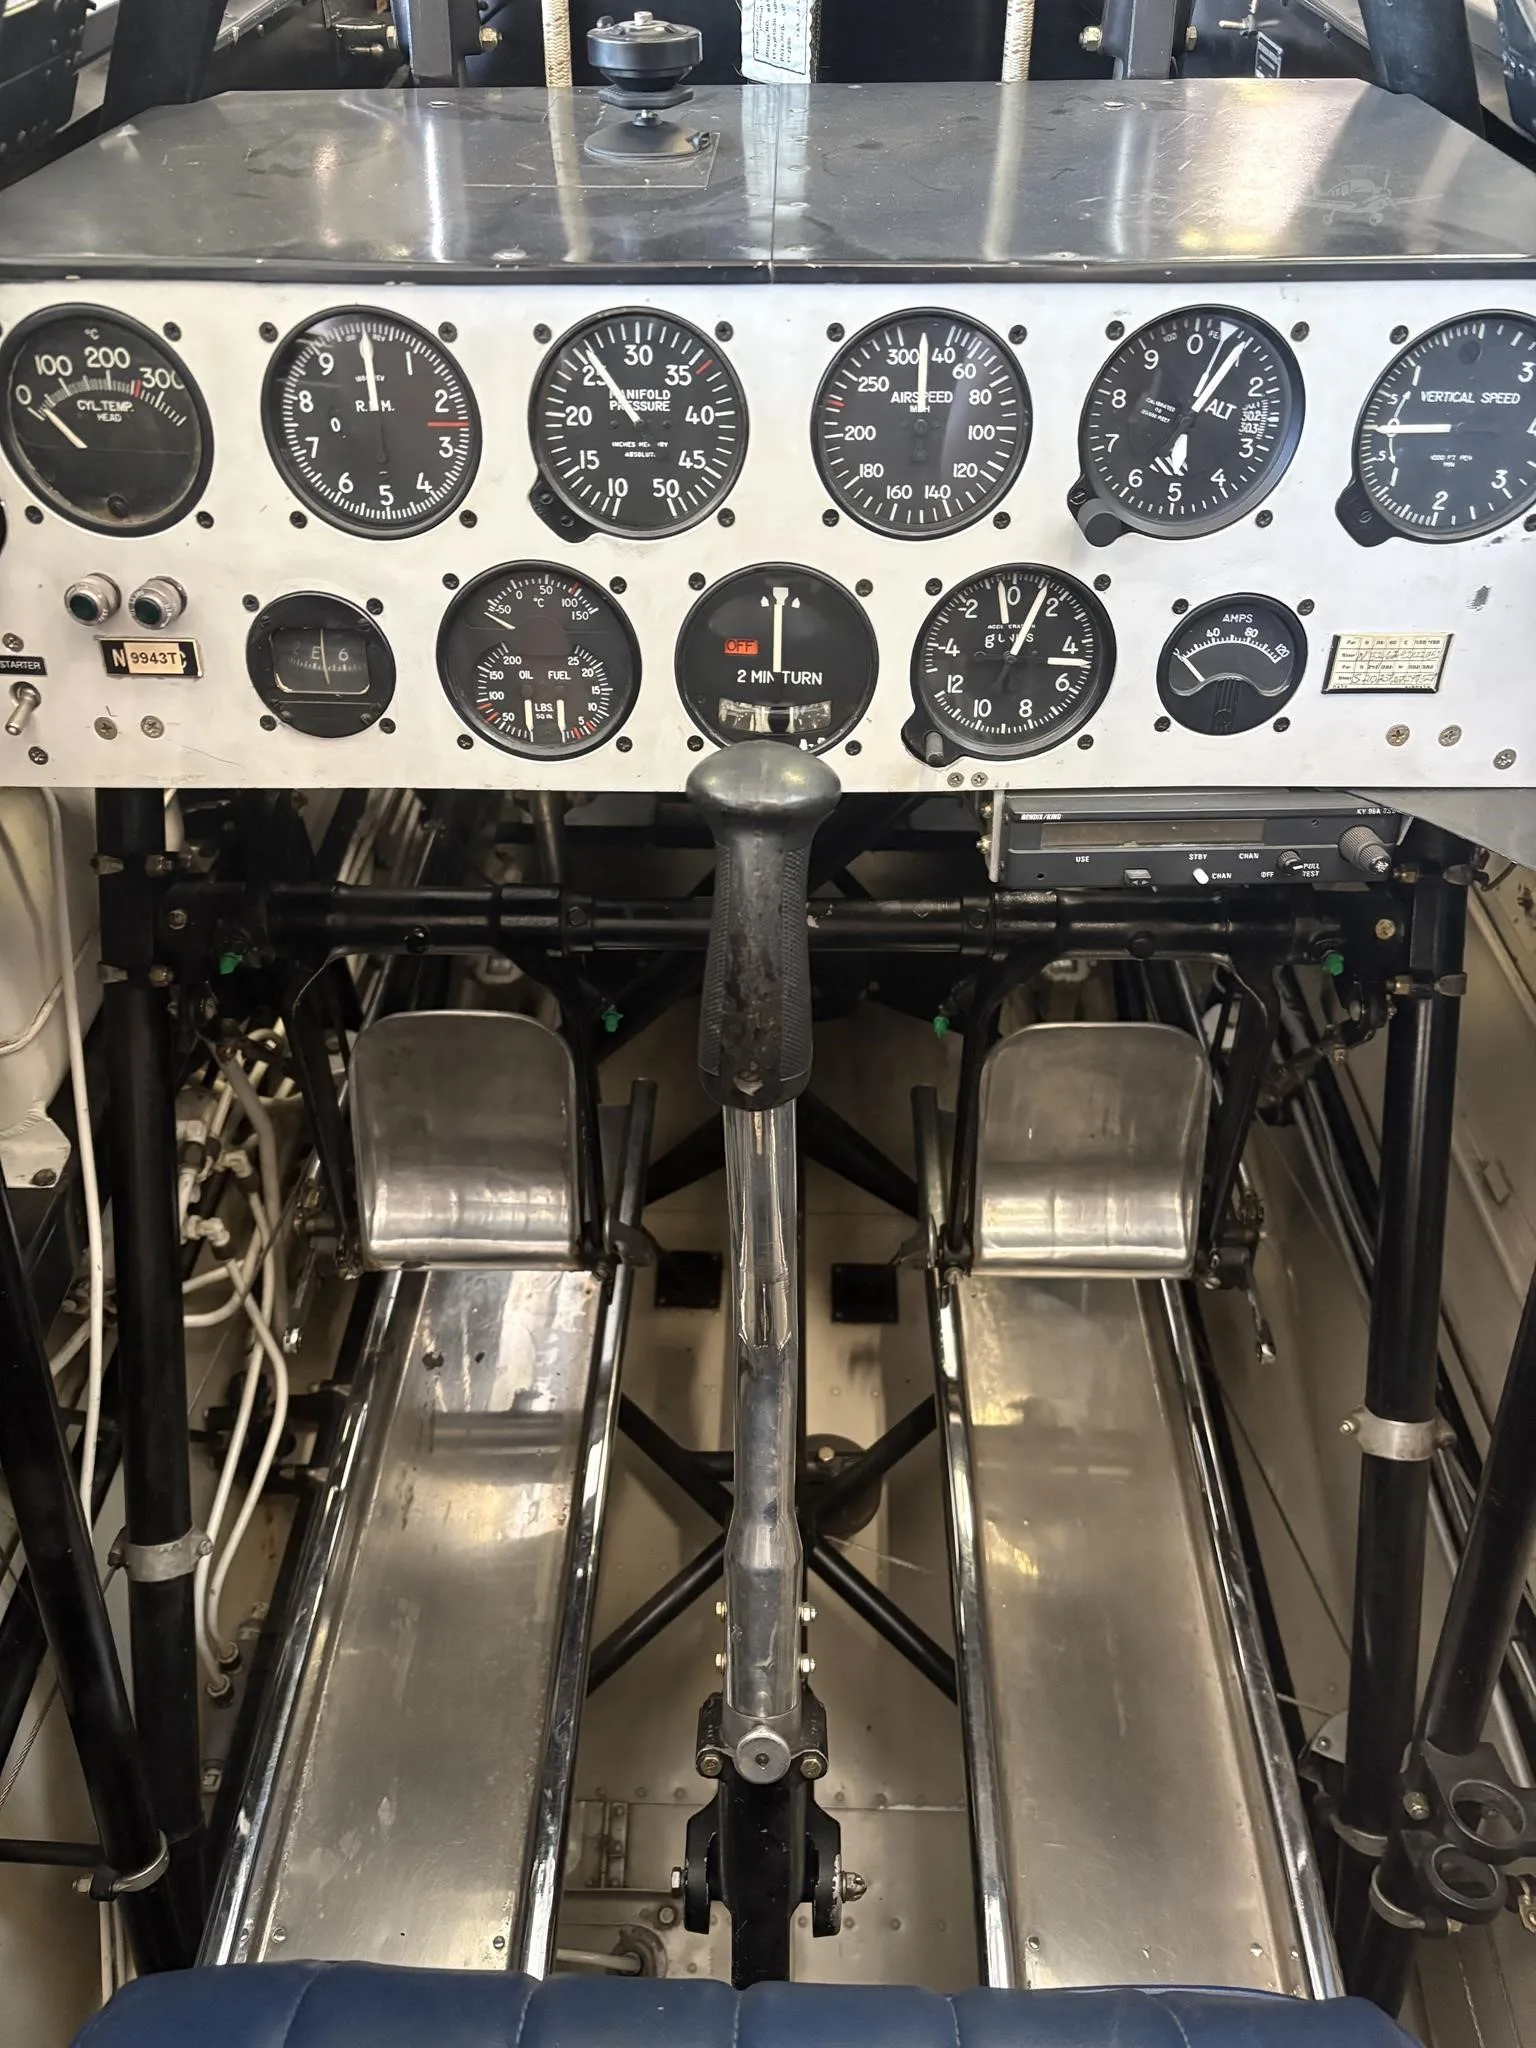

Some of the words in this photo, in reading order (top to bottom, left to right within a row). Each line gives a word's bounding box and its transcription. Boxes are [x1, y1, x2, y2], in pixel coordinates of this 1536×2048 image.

[1186, 333, 1204, 355] 0
[84, 346, 130, 369] 200
[318, 352, 334, 376] 9
[406, 351, 413, 375] 1
[624, 344, 653, 366] 30
[887, 349, 919, 365] 300
[932, 348, 956, 364] 40
[1144, 349, 1159, 370] 9
[34, 355, 73, 377] 100
[665, 364, 692, 386] 35
[952, 363, 976, 379] 60
[1518, 362, 1536, 382] 3
[139, 367, 185, 390] 300
[857, 376, 890, 392] 250
[1412, 366, 1421, 386] 1
[15, 384, 32, 405] 0
[1248, 377, 1263, 398] 2
[299, 390, 314, 413] 8
[435, 389, 450, 413] 2
[969, 389, 992, 405] 80
[1111, 389, 1127, 409] 8
[1421, 391, 1475, 403] VERTICAL
[1480, 392, 1521, 404] SPEED
[565, 406, 592, 426] 20
[685, 405, 715, 425] 40
[910, 405, 930, 413] MH
[1205, 398, 1237, 420] ALT
[330, 417, 341, 433] 0
[844, 425, 876, 441] 200
[968, 424, 995, 441] 100
[305, 436, 319, 459] 7
[439, 436, 454, 458] 3
[1106, 433, 1119, 452] 7
[1239, 438, 1253, 458] 3
[580, 450, 600, 470] 15
[678, 450, 706, 469] 45
[859, 463, 884, 478] 180
[953, 463, 978, 478] 120
[1129, 469, 1142, 487] 6
[1211, 469, 1226, 486] 4
[1390, 467, 1399, 486] 1
[1491, 469, 1508, 489] 3
[338, 472, 354, 494] 6
[416, 472, 432, 493] 4
[608, 478, 628, 497] 10
[652, 479, 680, 498] 50
[379, 485, 394, 506] 5
[886, 484, 913, 500] 160
[924, 484, 951, 500] 140
[1168, 483, 1182, 501] 5
[1432, 490, 1449, 510] 2
[516, 591, 523, 600] 0
[540, 585, 553, 595] 50
[1007, 586, 1021, 606] 0
[562, 598, 578, 608] 100
[958, 599, 978, 619] -2
[1045, 597, 1059, 617] 2
[572, 611, 589, 621] 150
[1222, 614, 1253, 623] AMPS
[1206, 627, 1221, 637] 40
[1244, 627, 1259, 638] 80
[727, 640, 753, 652] OFF
[938, 638, 960, 656] -4
[1063, 635, 1078, 654] 4
[1274, 643, 1290, 658] 120
[112, 648, 126, 668] N
[130, 652, 177, 664] 9943T
[311, 646, 321, 660] E
[338, 648, 349, 662] 6
[503, 656, 522, 665] 200
[568, 656, 580, 666] 25
[0, 660, 42, 670] STARTER
[582, 668, 594, 677] 20
[490, 671, 504, 680] 150
[519, 671, 533, 680] OIL
[548, 671, 571, 680] FUEL
[737, 670, 746, 683] 2
[751, 670, 775, 683] MIN
[782, 671, 823, 685] TURN
[947, 675, 964, 693] 12
[1055, 673, 1069, 691] 6
[489, 691, 504, 700] 100
[592, 686, 601, 695] 15
[588, 702, 598, 711] 10
[974, 699, 991, 717] 10
[1019, 699, 1032, 717] 8
[502, 712, 515, 722] 50
[578, 716, 585, 725] 5
[1021, 813, 1062, 821] BENDIX/KING
[1302, 870, 1320, 878] TEST
